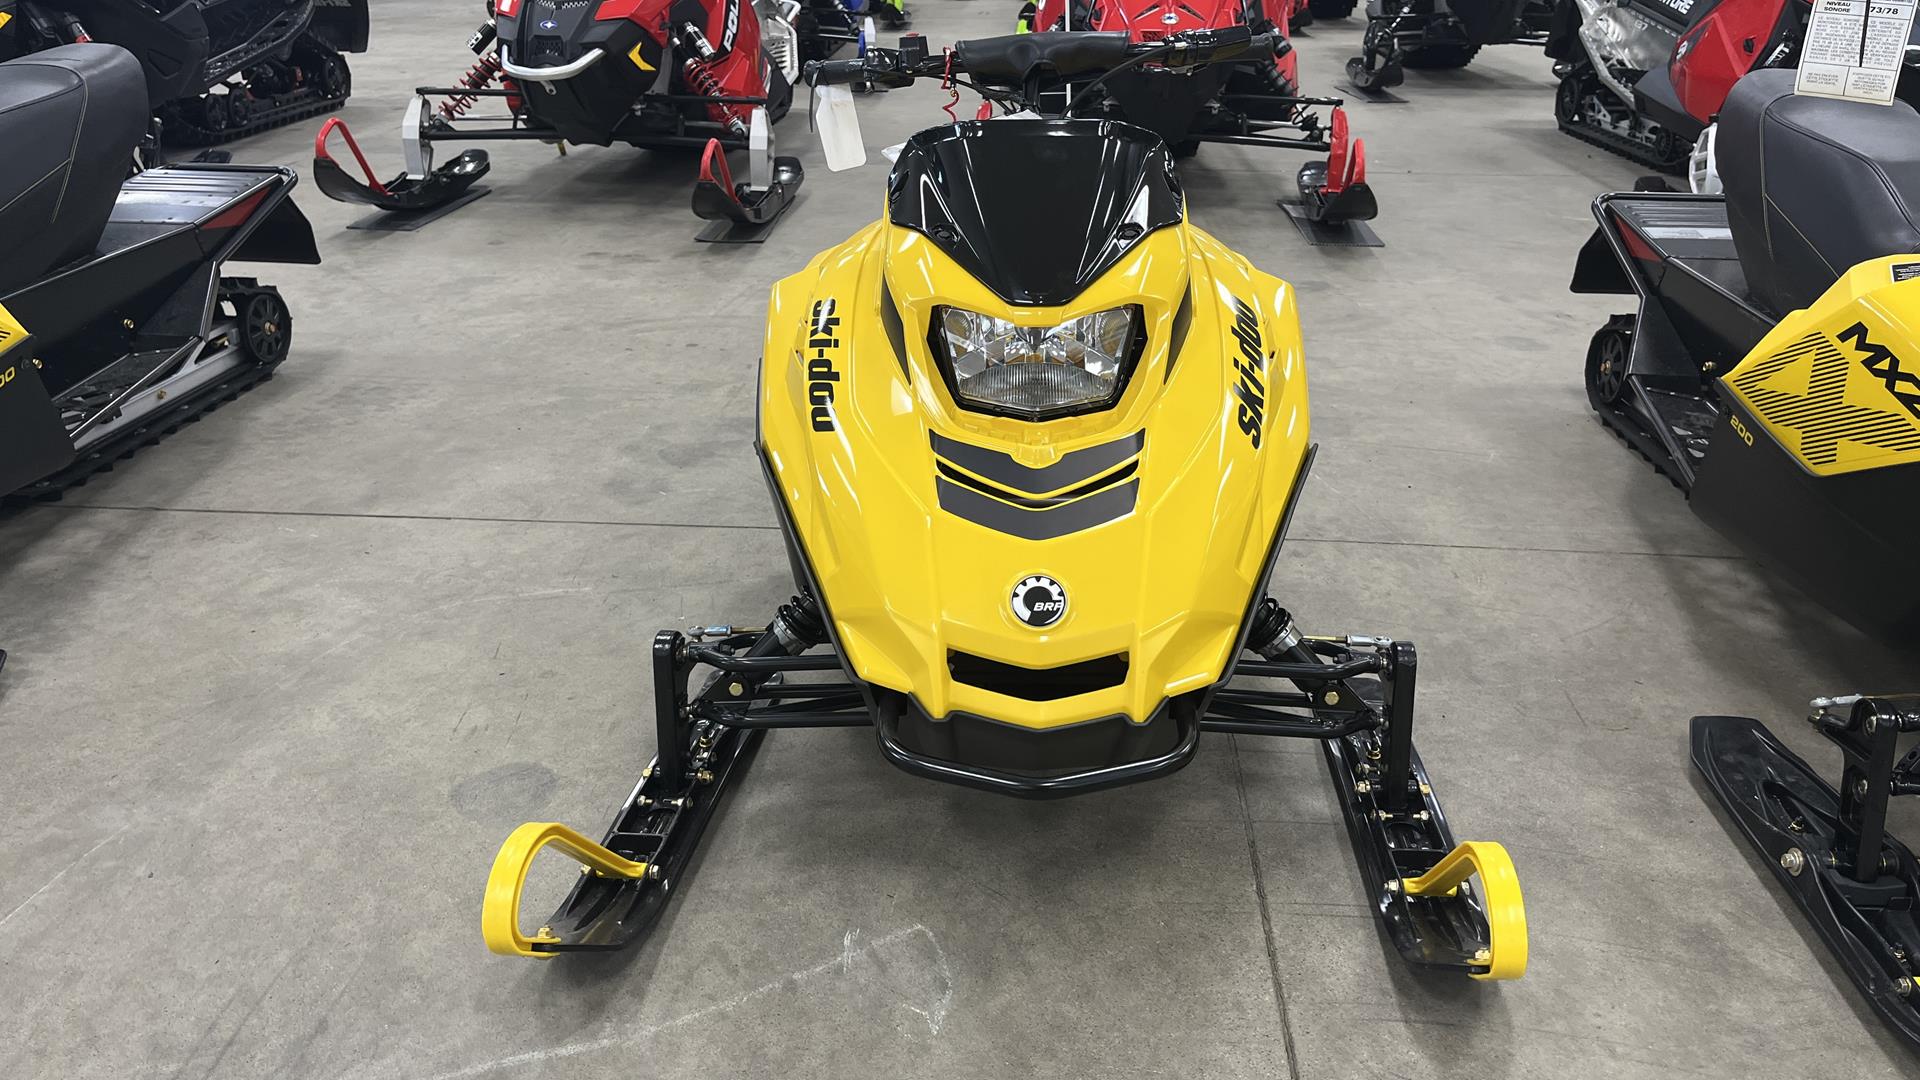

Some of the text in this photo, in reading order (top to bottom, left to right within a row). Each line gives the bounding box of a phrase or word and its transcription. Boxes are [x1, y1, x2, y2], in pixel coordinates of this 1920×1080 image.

[1870, 6, 1899, 15] 73/78
[808, 298, 841, 432] ski-doo
[1730, 414, 1754, 447] 200
[1033, 602, 1062, 611] BRP
